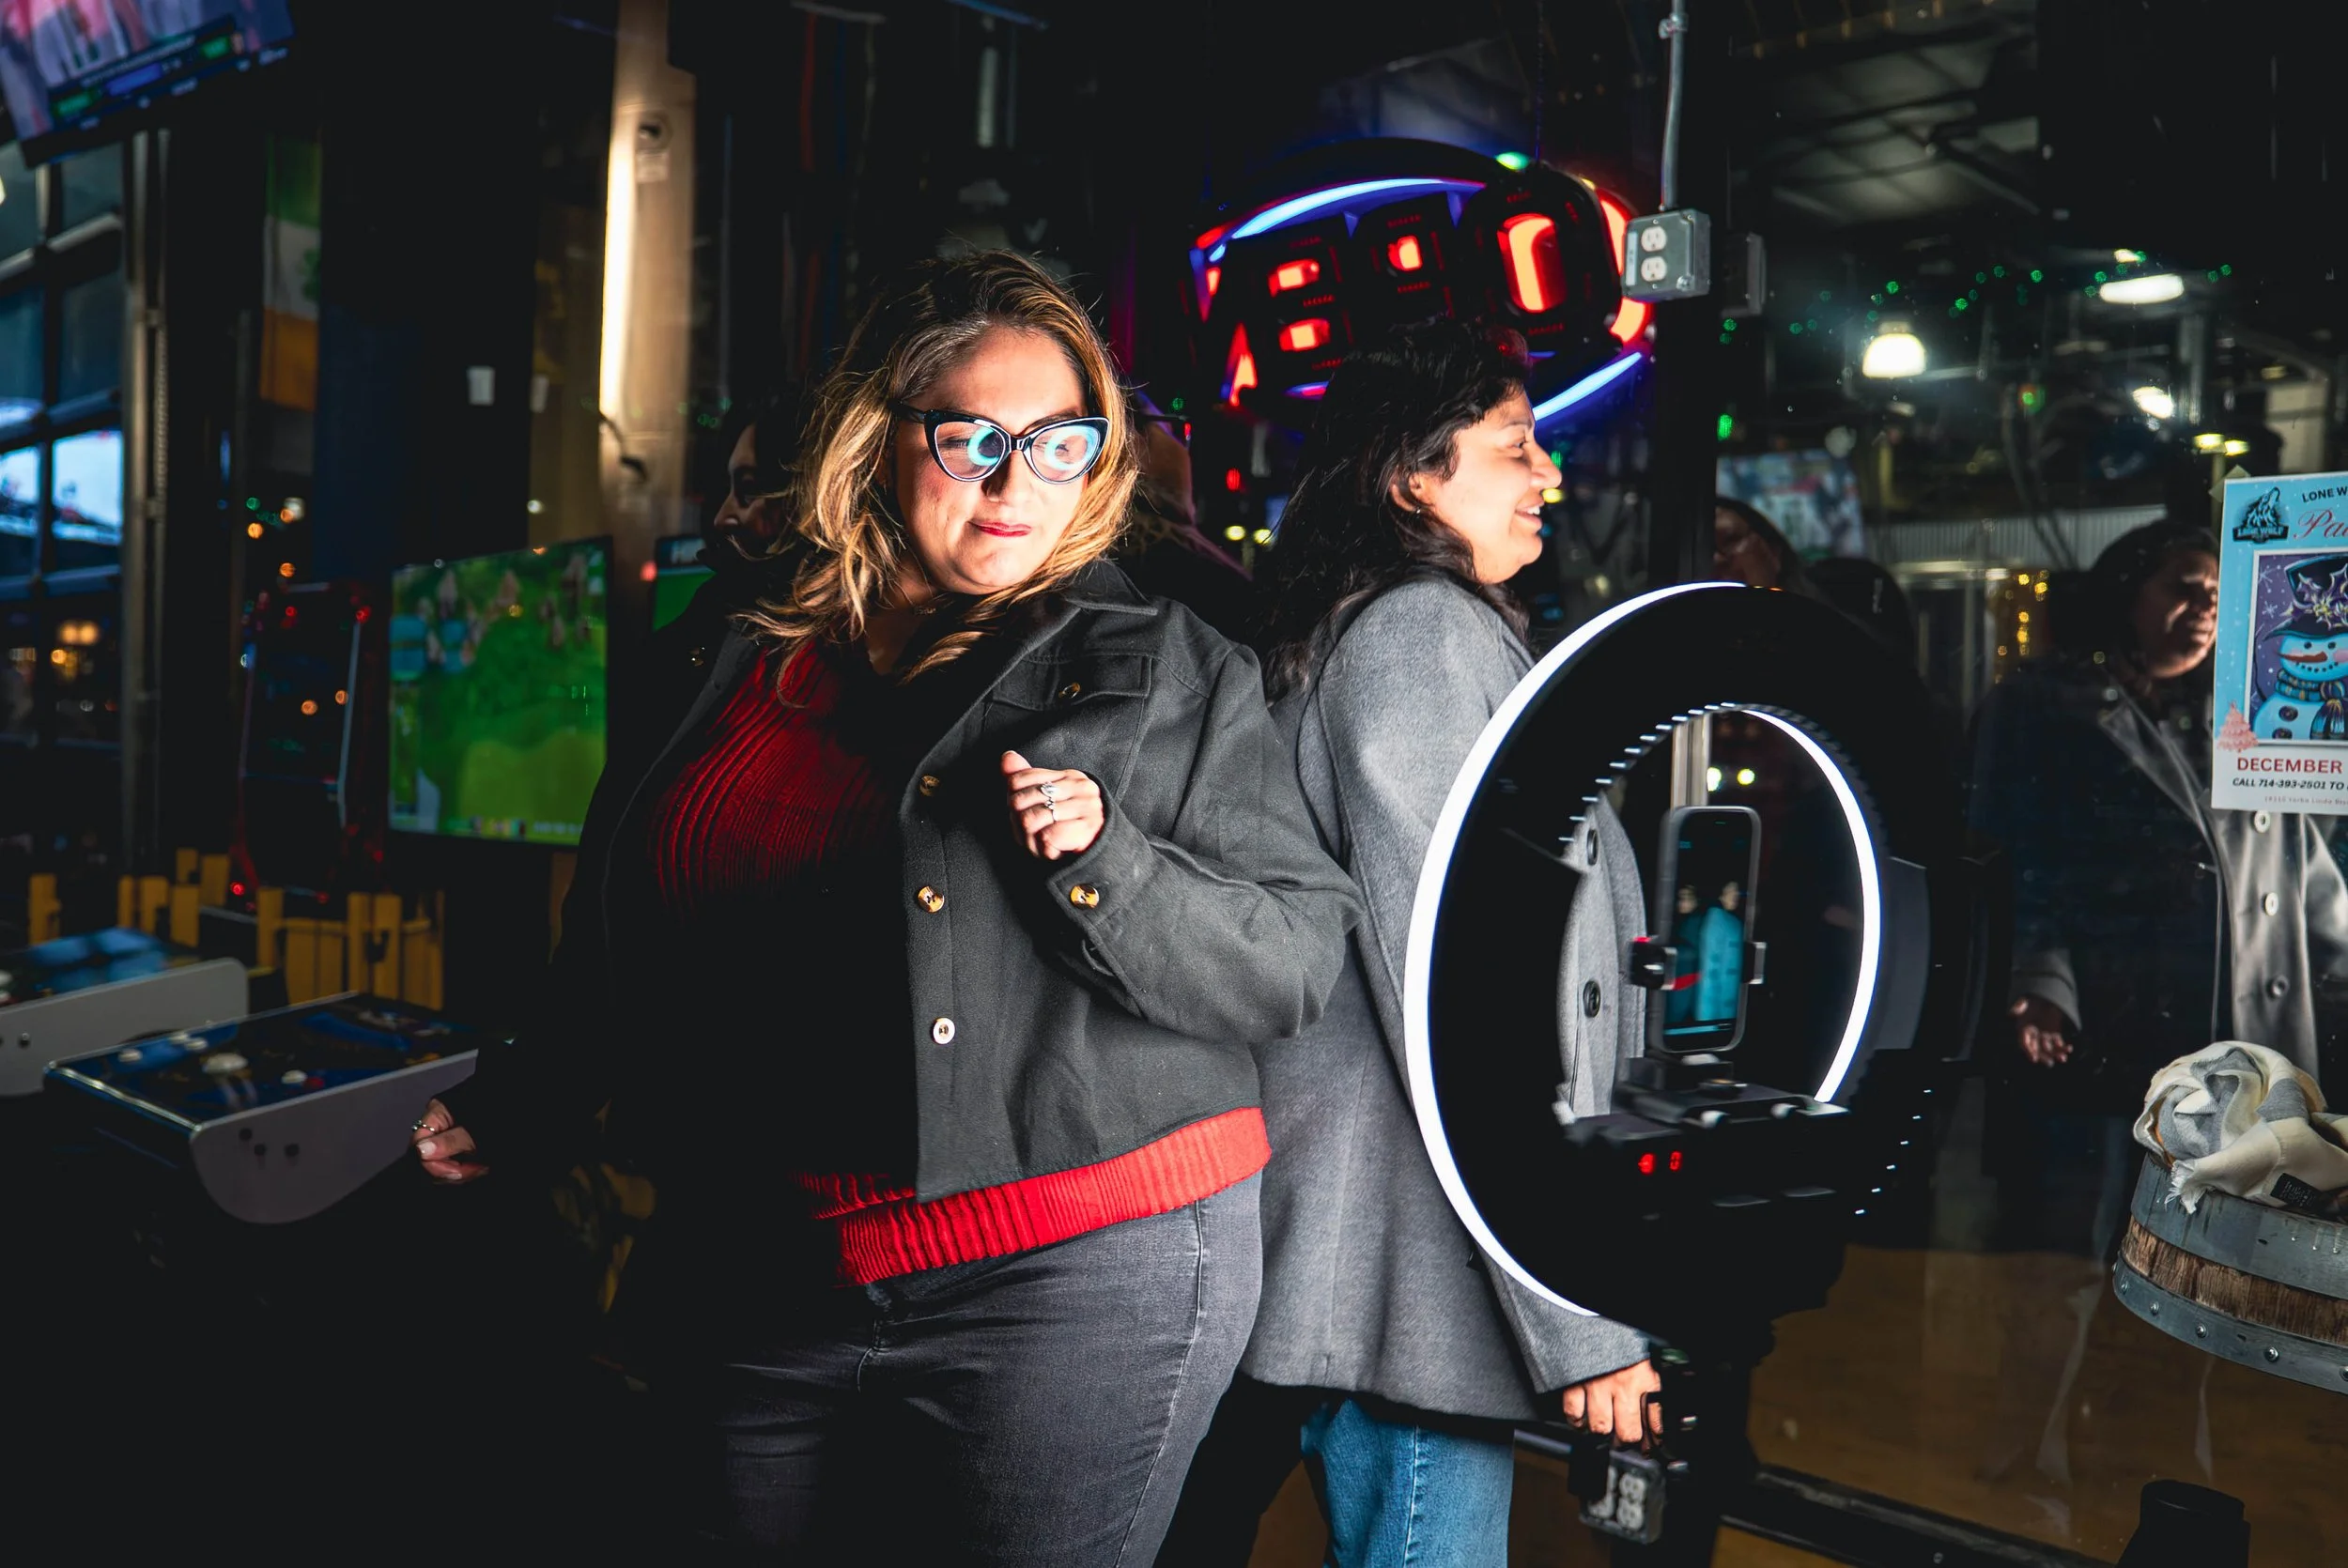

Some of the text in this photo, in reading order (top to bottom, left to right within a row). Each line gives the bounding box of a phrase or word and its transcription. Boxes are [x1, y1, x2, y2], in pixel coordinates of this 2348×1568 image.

[2301, 488, 2335, 503] LONE
[2236, 757, 2343, 775] DECEMBER
[2232, 777, 2256, 788] CALL
[2329, 780, 2345, 791] TO
